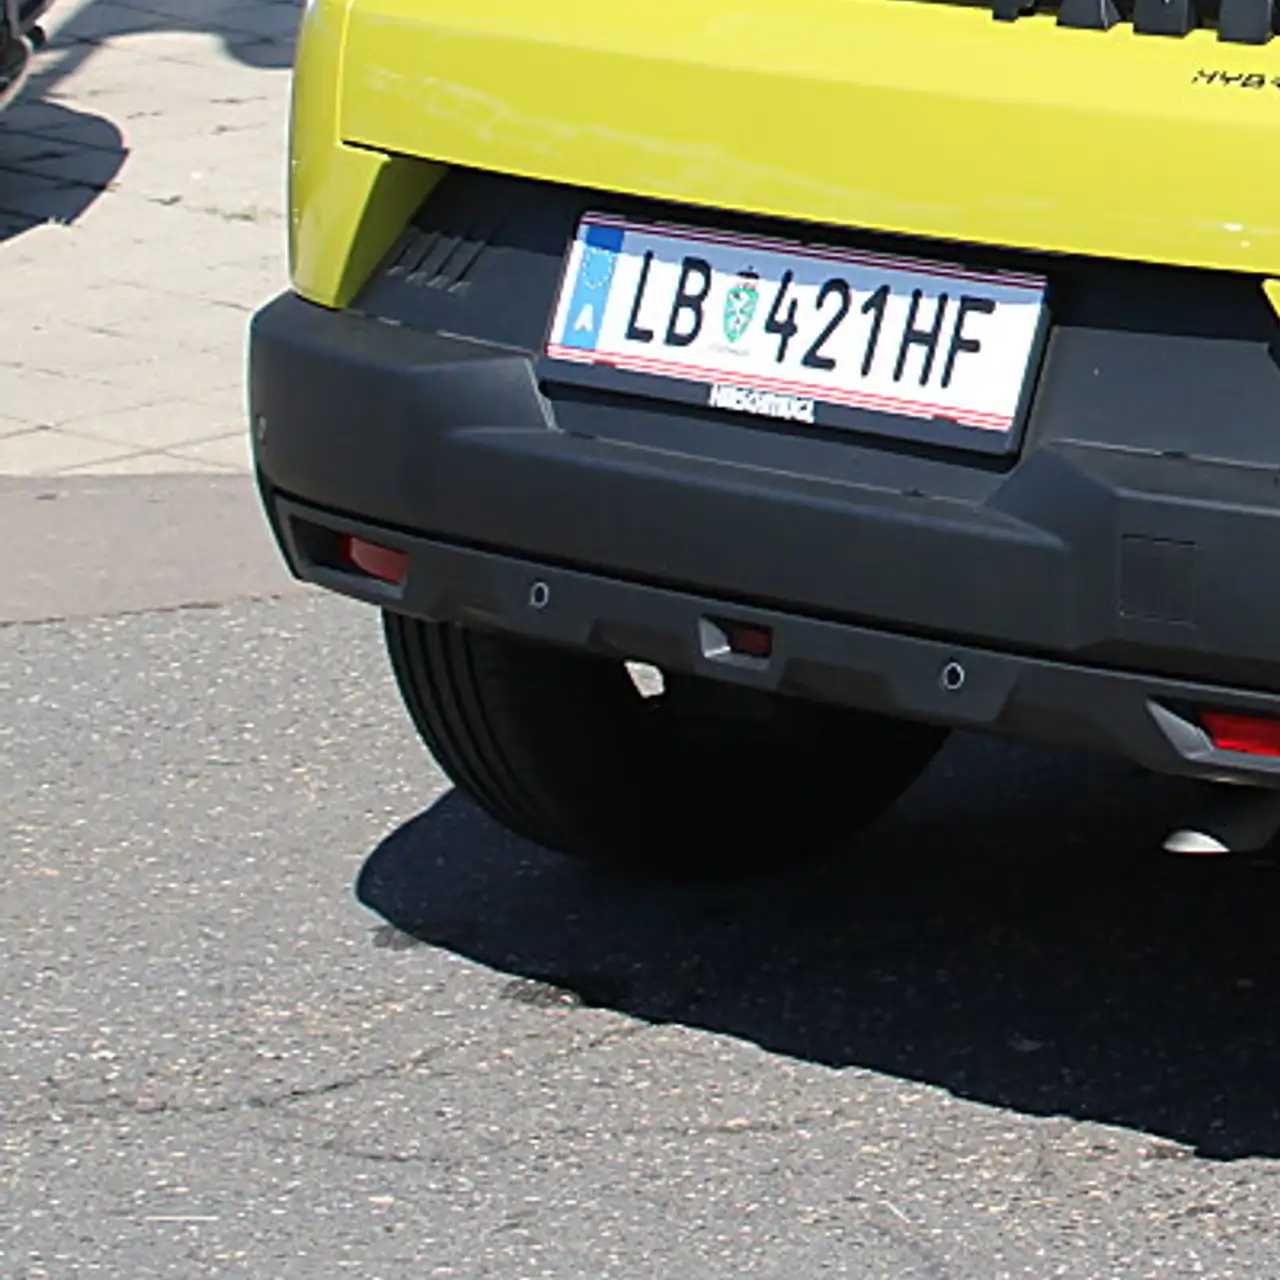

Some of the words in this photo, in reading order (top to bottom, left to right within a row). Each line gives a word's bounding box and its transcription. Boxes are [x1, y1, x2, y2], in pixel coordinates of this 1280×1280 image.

[572, 303, 595, 332] A
[624, 249, 712, 347] LB
[764, 269, 997, 389] 421HF
